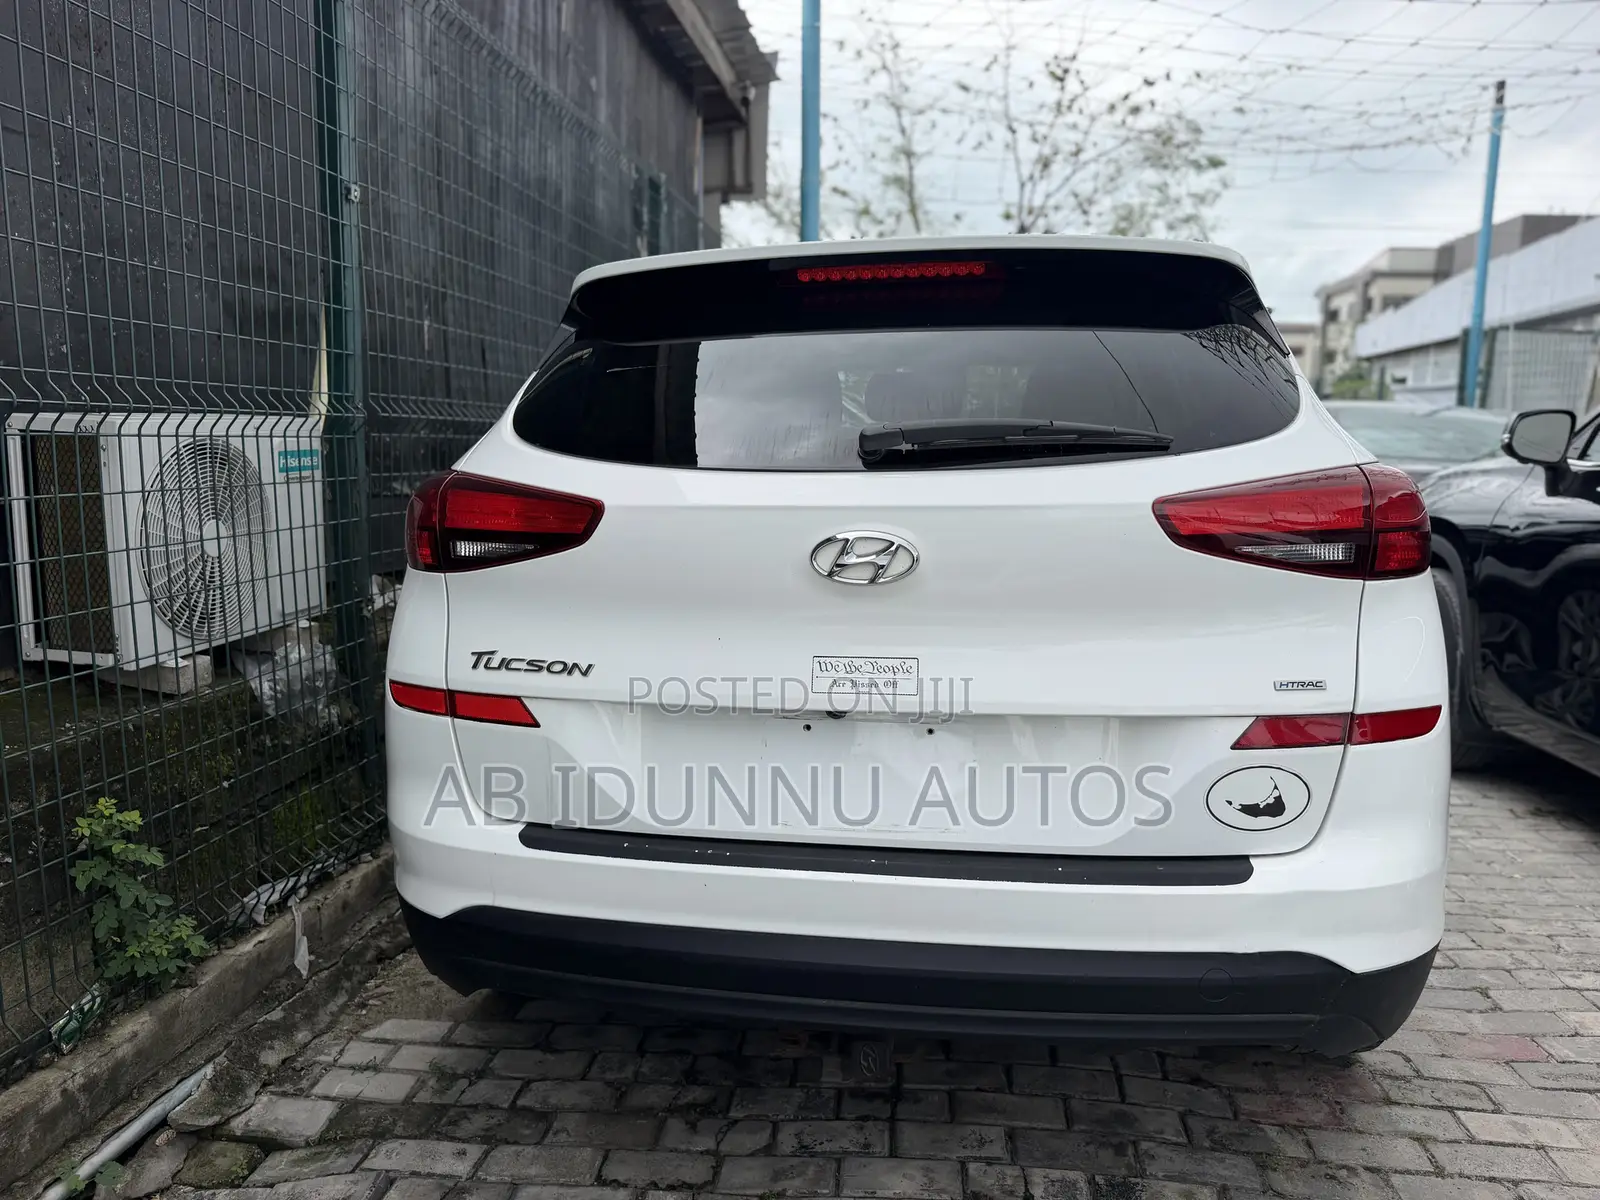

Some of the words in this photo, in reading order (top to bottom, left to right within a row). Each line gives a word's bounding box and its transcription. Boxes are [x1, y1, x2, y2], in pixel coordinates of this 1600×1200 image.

[816, 660, 842, 673] We
[863, 660, 914, 676] People
[831, 679, 846, 688] Are
[850, 679, 879, 690] Pissed
[883, 680, 899, 688] Off
[1279, 681, 1323, 689] HTRAC
